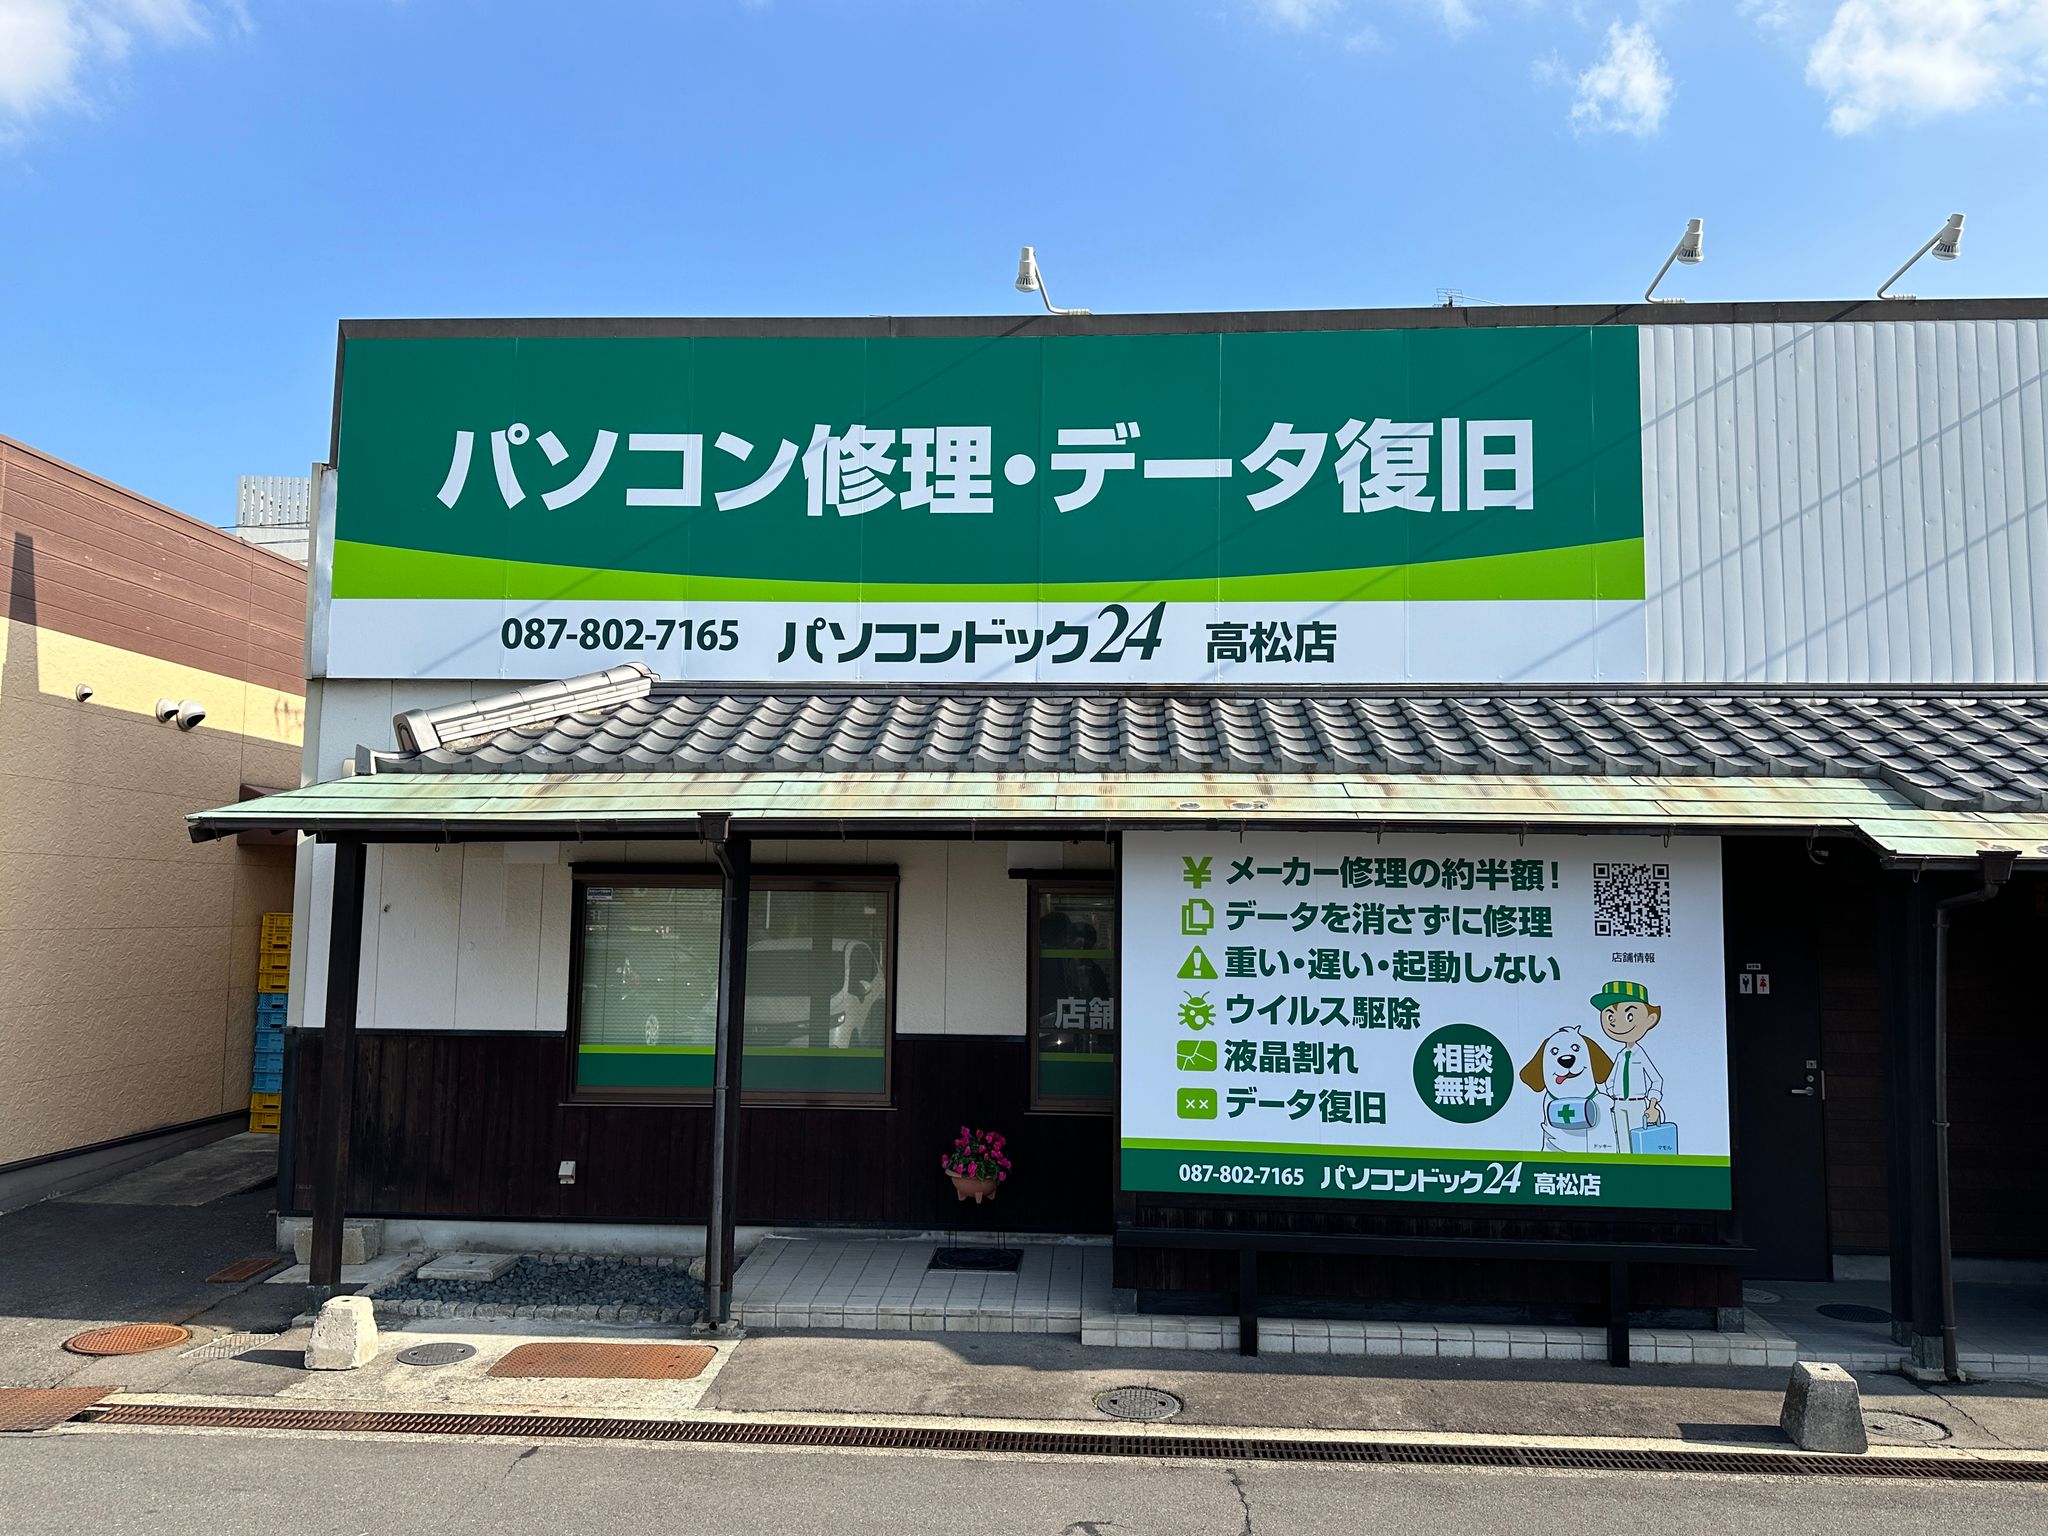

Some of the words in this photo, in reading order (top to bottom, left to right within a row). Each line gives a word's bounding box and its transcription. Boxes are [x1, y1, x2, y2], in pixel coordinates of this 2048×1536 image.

[437, 418, 1534, 517] パソコン修理・データ復旧
[502, 618, 739, 652] 087-802-7165
[778, 601, 1166, 664] パソコンドック24
[1206, 621, 1337, 664] 高松店
[1226, 899, 1553, 938] データを消さずに修理
[1225, 946, 1561, 984] 重い・遅い・起動しない
[1611, 952, 1656, 964] 店舗情報
[1226, 994, 1421, 1030] ウイルス駆除
[1225, 1040, 1359, 1075] 液晶割れ
[1433, 1043, 1494, 1074] 相談
[1226, 1087, 1387, 1125] データ復旧
[1433, 1075, 1495, 1106] 無料
[1179, 1164, 1305, 1186] 087-802-7165
[1321, 1161, 1523, 1195] パソコンドック24
[1534, 1172, 1602, 1197] 高松店
